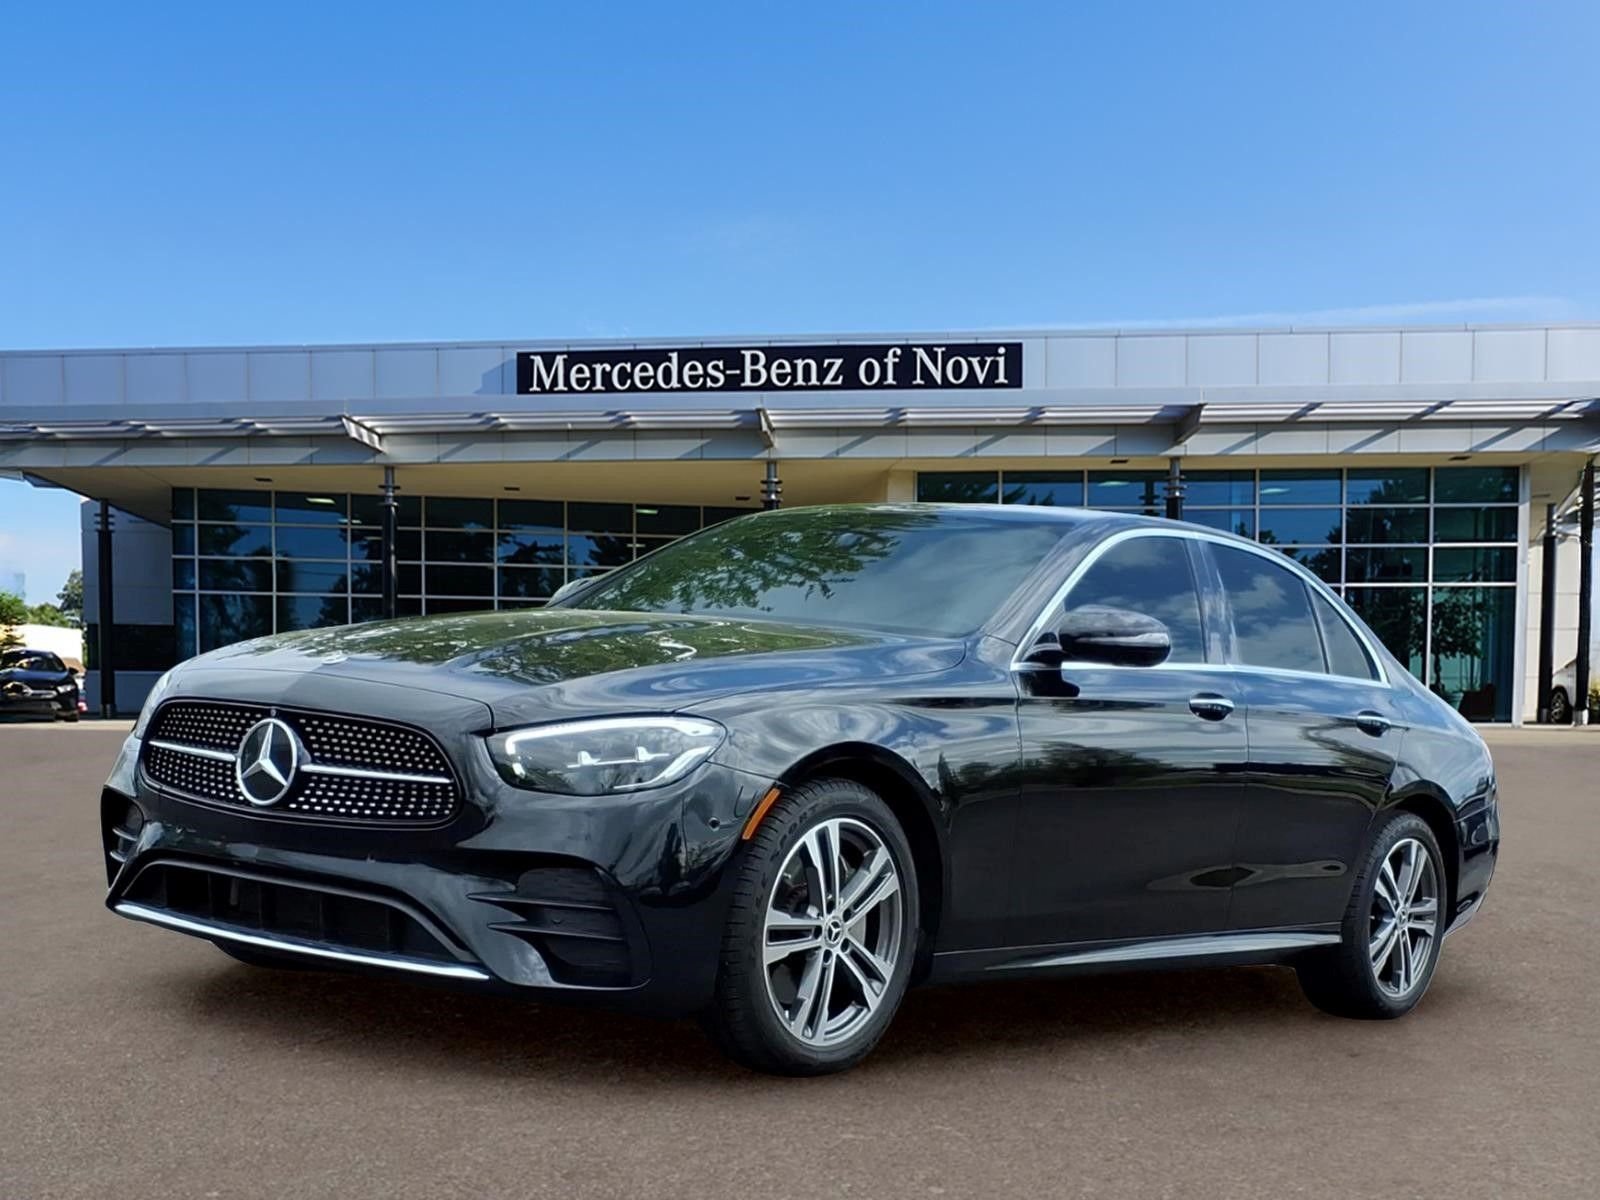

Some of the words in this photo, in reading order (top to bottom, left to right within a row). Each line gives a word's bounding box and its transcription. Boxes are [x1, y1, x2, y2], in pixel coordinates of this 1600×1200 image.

[529, 350, 844, 392] Mercedes-Benz
[859, 347, 901, 386] of
[913, 346, 1008, 385] Novi
